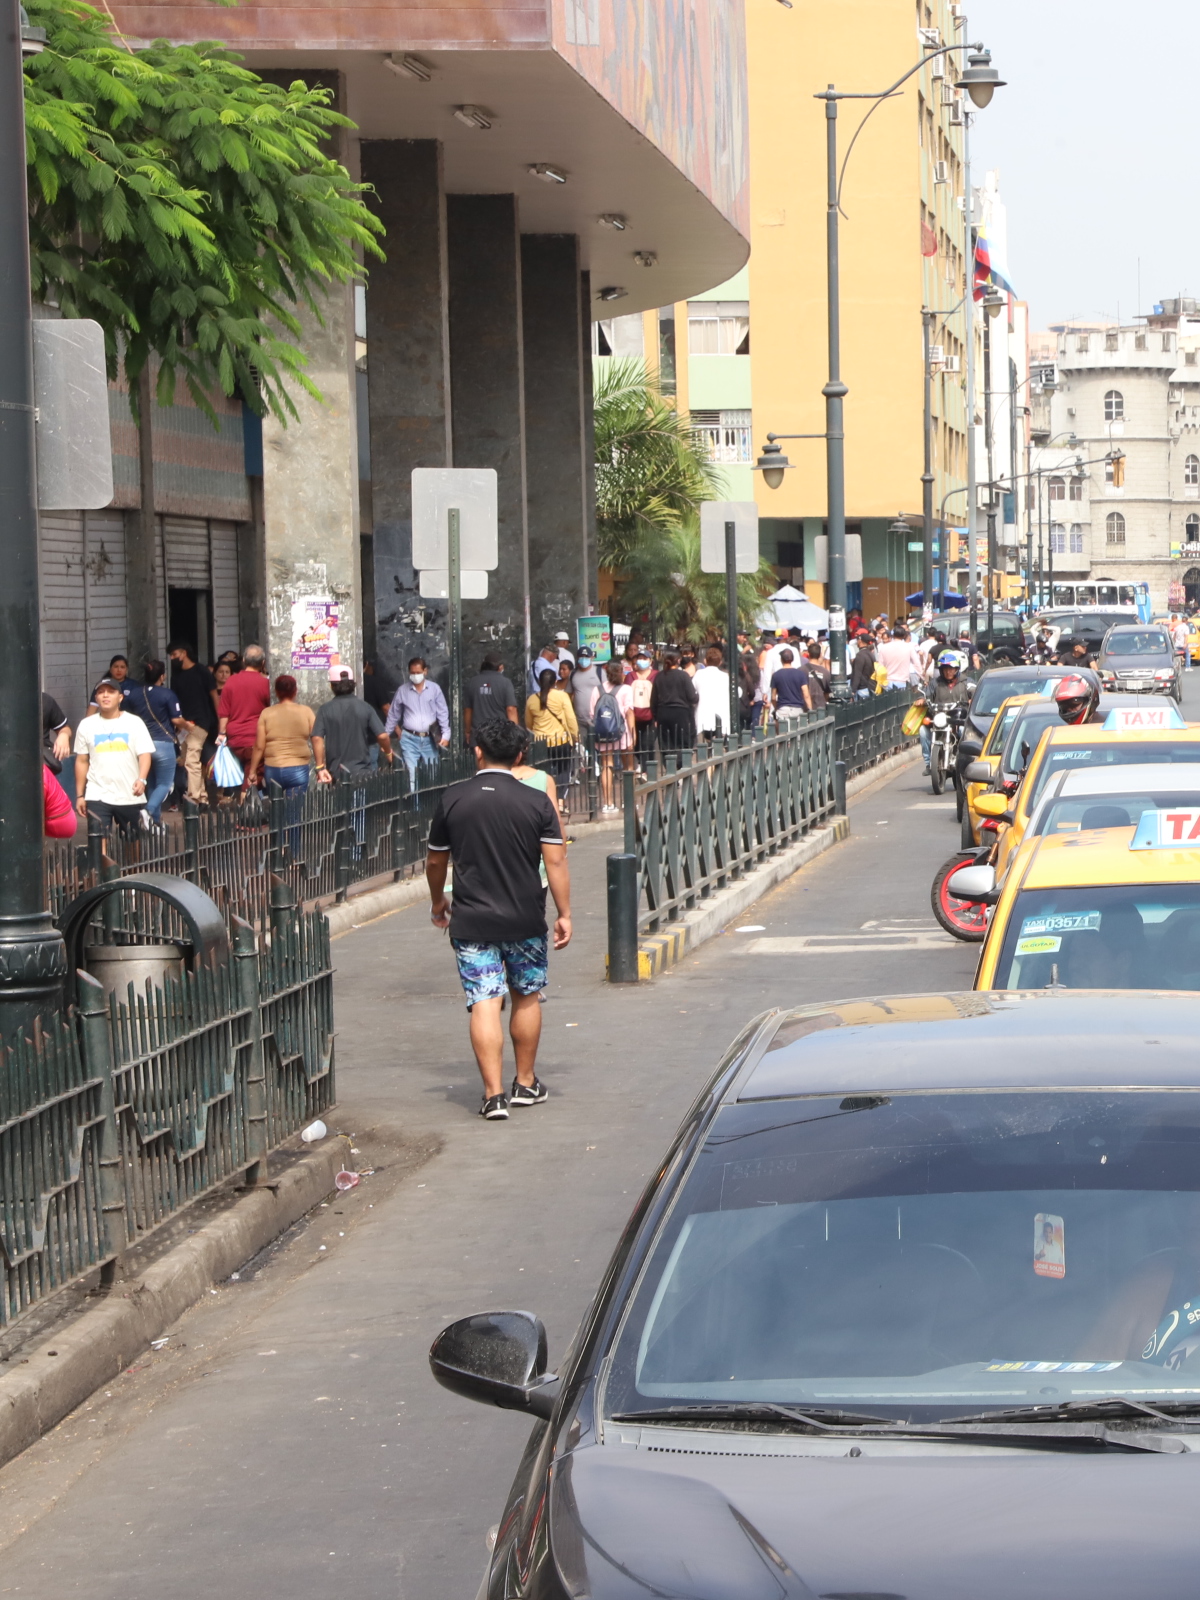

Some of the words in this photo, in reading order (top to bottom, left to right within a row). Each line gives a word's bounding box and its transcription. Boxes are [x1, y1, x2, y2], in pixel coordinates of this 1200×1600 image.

[1121, 711, 1164, 725] TAXI
[1026, 919, 1045, 927] TAXI
[1045, 916, 1089, 929] 03571
